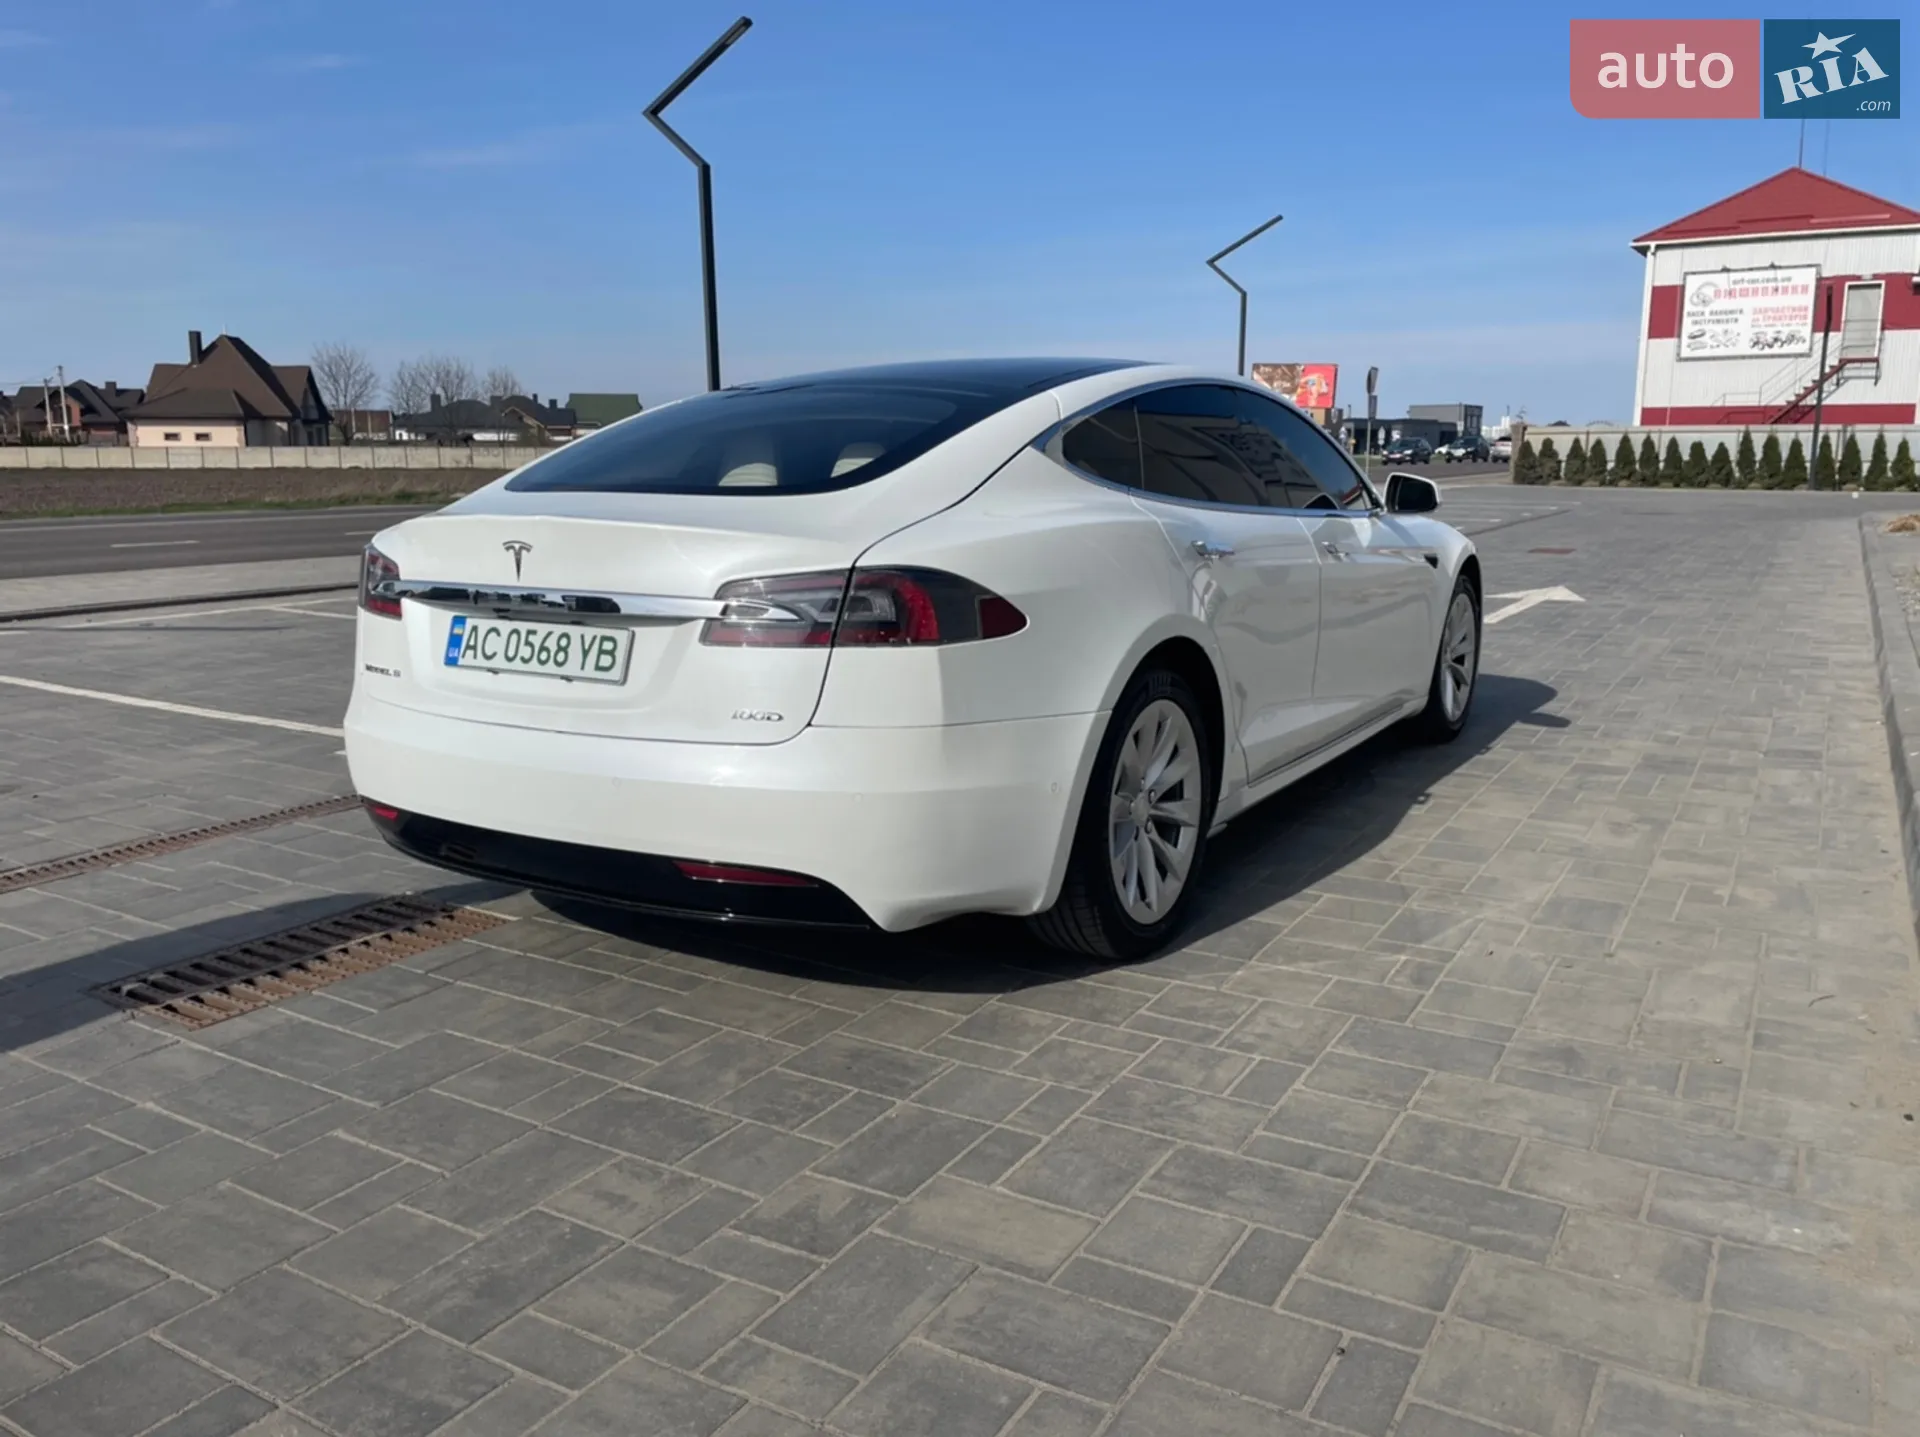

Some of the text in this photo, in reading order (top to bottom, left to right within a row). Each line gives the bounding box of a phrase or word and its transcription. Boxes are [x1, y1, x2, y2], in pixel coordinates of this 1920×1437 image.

[461, 625, 618, 672] AC 0568 YB
